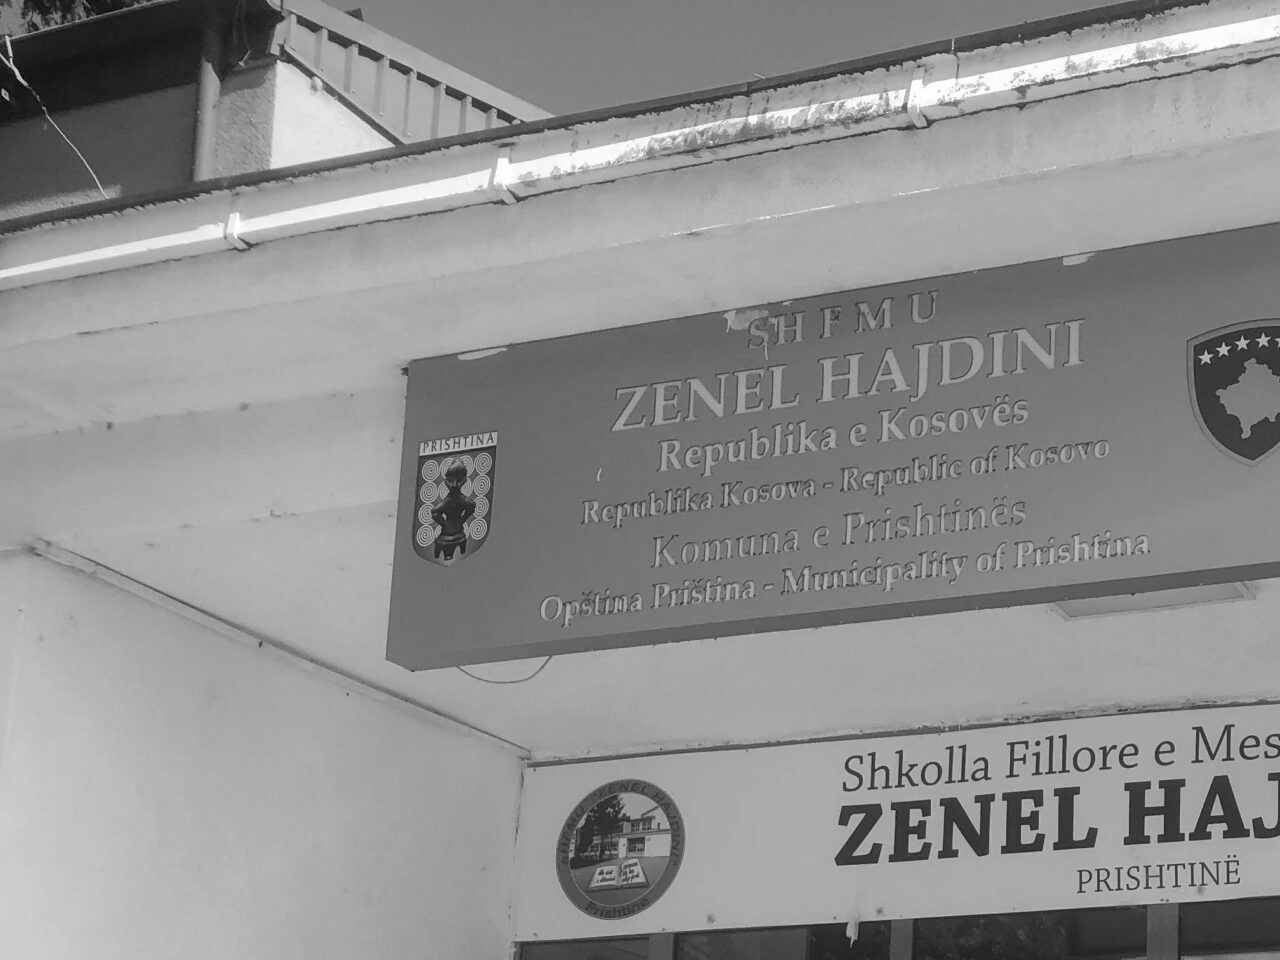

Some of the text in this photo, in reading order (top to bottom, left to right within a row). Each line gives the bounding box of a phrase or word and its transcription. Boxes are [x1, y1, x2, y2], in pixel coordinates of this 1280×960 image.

[819, 305, 843, 339] F
[855, 297, 895, 333] M
[908, 290, 940, 324] U
[610, 319, 1086, 432] ZENEL HAJDINI
[422, 432, 495, 454] PRISHTINA
[656, 393, 1029, 477] Republika e Kosovës
[581, 486, 713, 528] Republika
[720, 478, 817, 508] Kosova
[840, 454, 962, 496] Republic
[969, 446, 999, 475] of
[1005, 438, 1110, 471] Kosovo
[651, 496, 1028, 568] Komuna e Prishtinës
[540, 588, 644, 628] Opština
[651, 575, 756, 609] Priština
[780, 550, 968, 596] Municipality
[976, 542, 1007, 574] of
[1013, 530, 1151, 570] Prishtina
[842, 744, 992, 792] Shkolla
[1005, 734, 1140, 779] Fillore
[1154, 739, 1176, 766] e
[834, 786, 1098, 866] ZENEL
[1076, 854, 1241, 893] PRISHTINË
